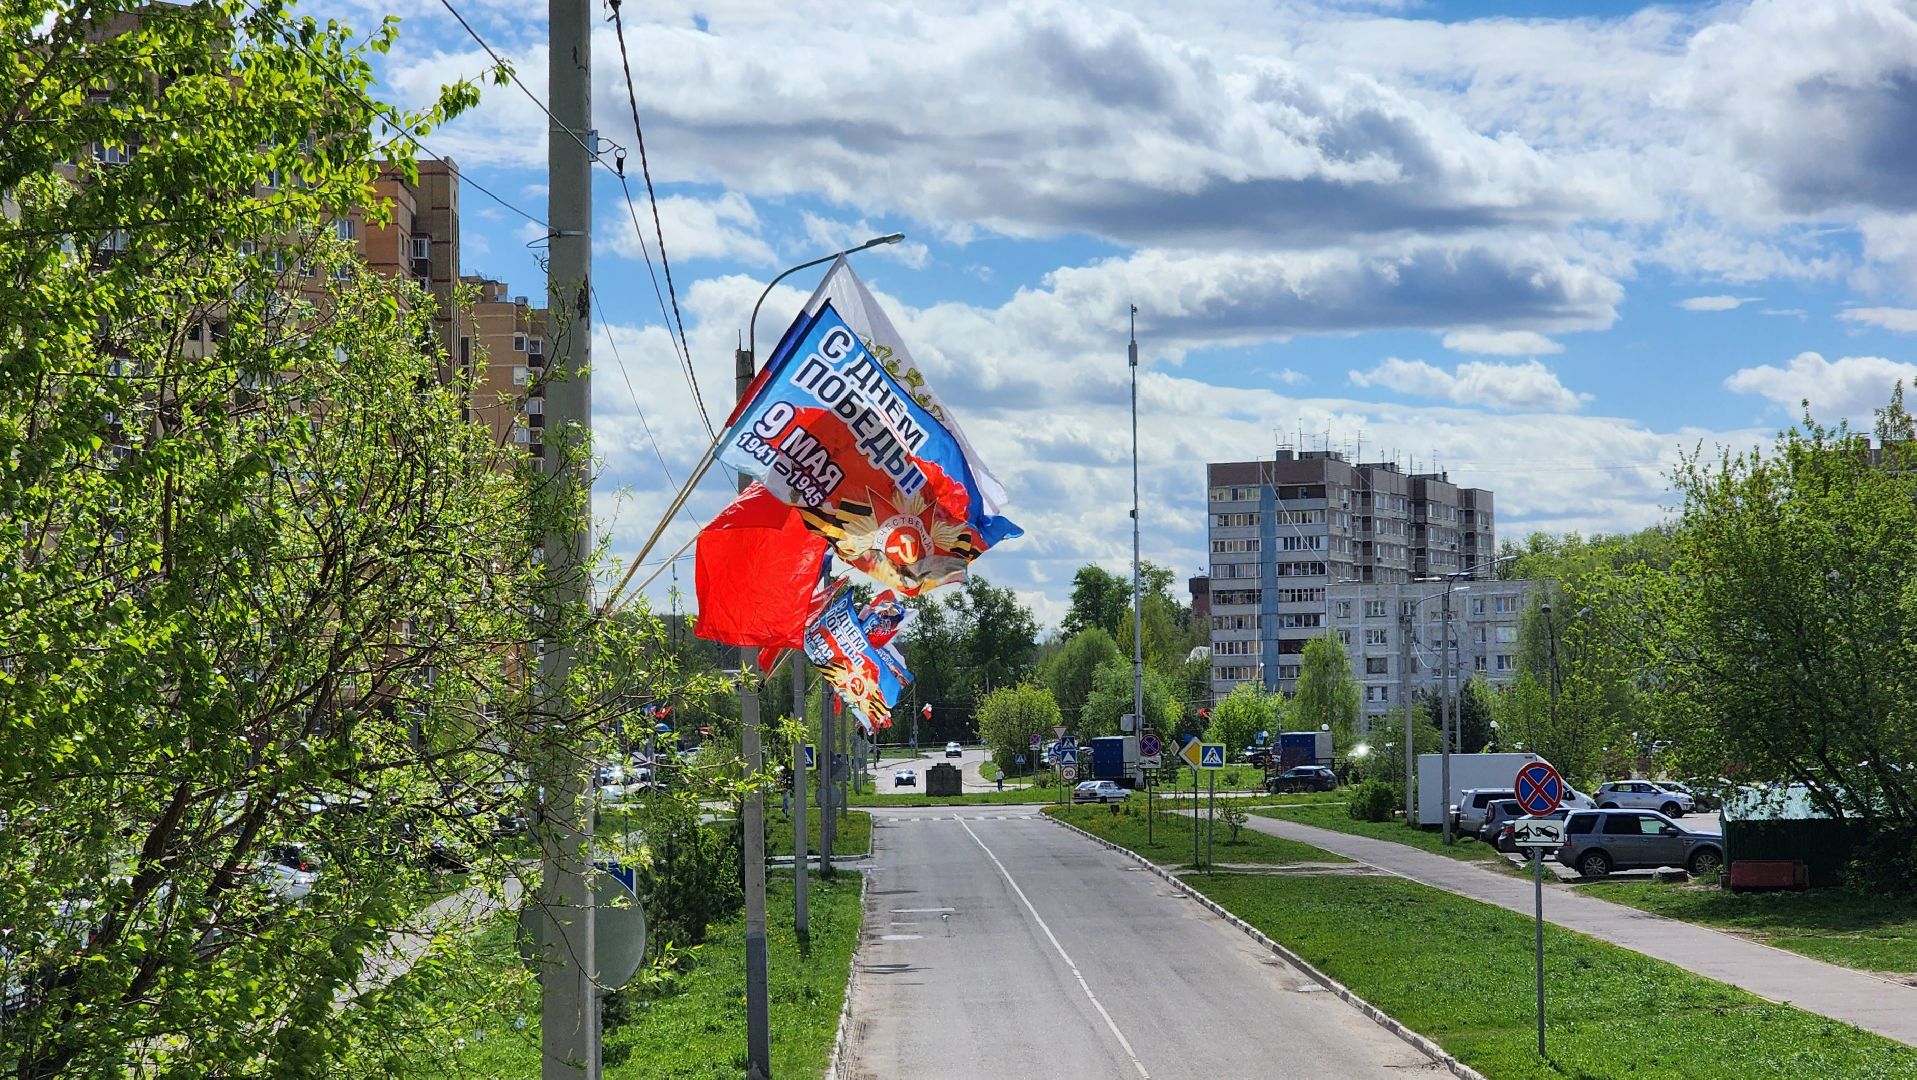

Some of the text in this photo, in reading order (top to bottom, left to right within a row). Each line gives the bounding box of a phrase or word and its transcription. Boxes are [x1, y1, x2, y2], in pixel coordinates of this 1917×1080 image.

[821, 329, 851, 361] С
[755, 402, 843, 492] 9 МАЯ
[796, 358, 924, 495] ПОБЕДЫ!
[812, 633, 834, 660] МАЯ
